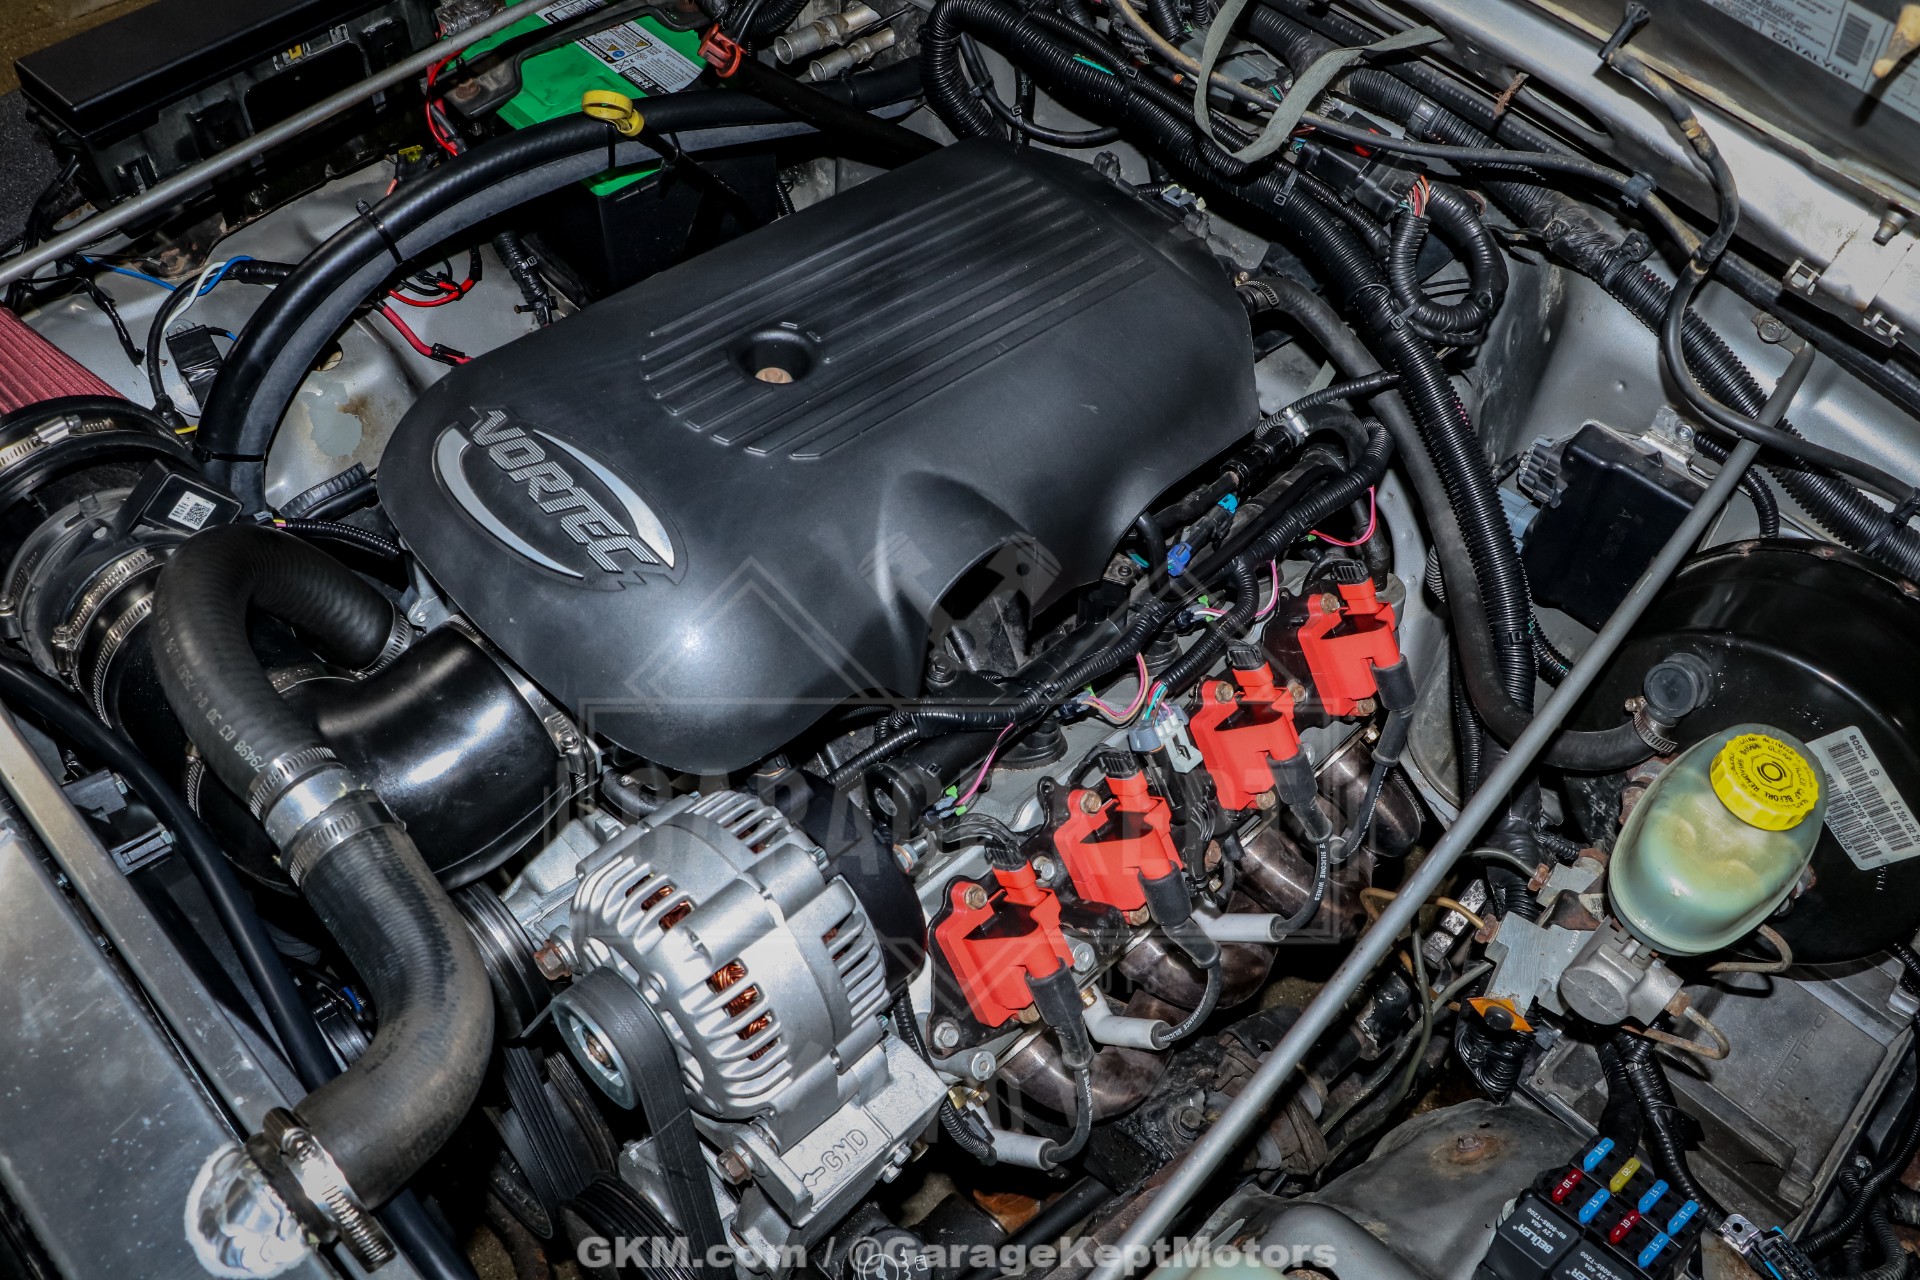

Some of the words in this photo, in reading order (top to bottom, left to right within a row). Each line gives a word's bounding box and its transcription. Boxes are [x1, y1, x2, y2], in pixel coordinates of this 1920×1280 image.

[1771, 31, 1851, 80] CATALYST
[473, 410, 660, 574] VORTEC
[205, 708, 222, 726] 30
[219, 724, 236, 742] 03
[1849, 734, 1869, 760] BOSCH
[234, 740, 268, 773] 79498
[1314, 881, 1325, 901] WIRES
[821, 1129, 868, 1172] GND
[1562, 1178, 1573, 1189] 10
[1649, 1187, 1660, 1198] 15
[1589, 1198, 1600, 1208] 15
[1530, 1217, 1544, 1230] 40A
[1620, 1219, 1631, 1229] 10
[1541, 1226, 1555, 1240] 12V
[1649, 1241, 1660, 1252] 15
[1584, 1262, 1597, 1273] 40A
